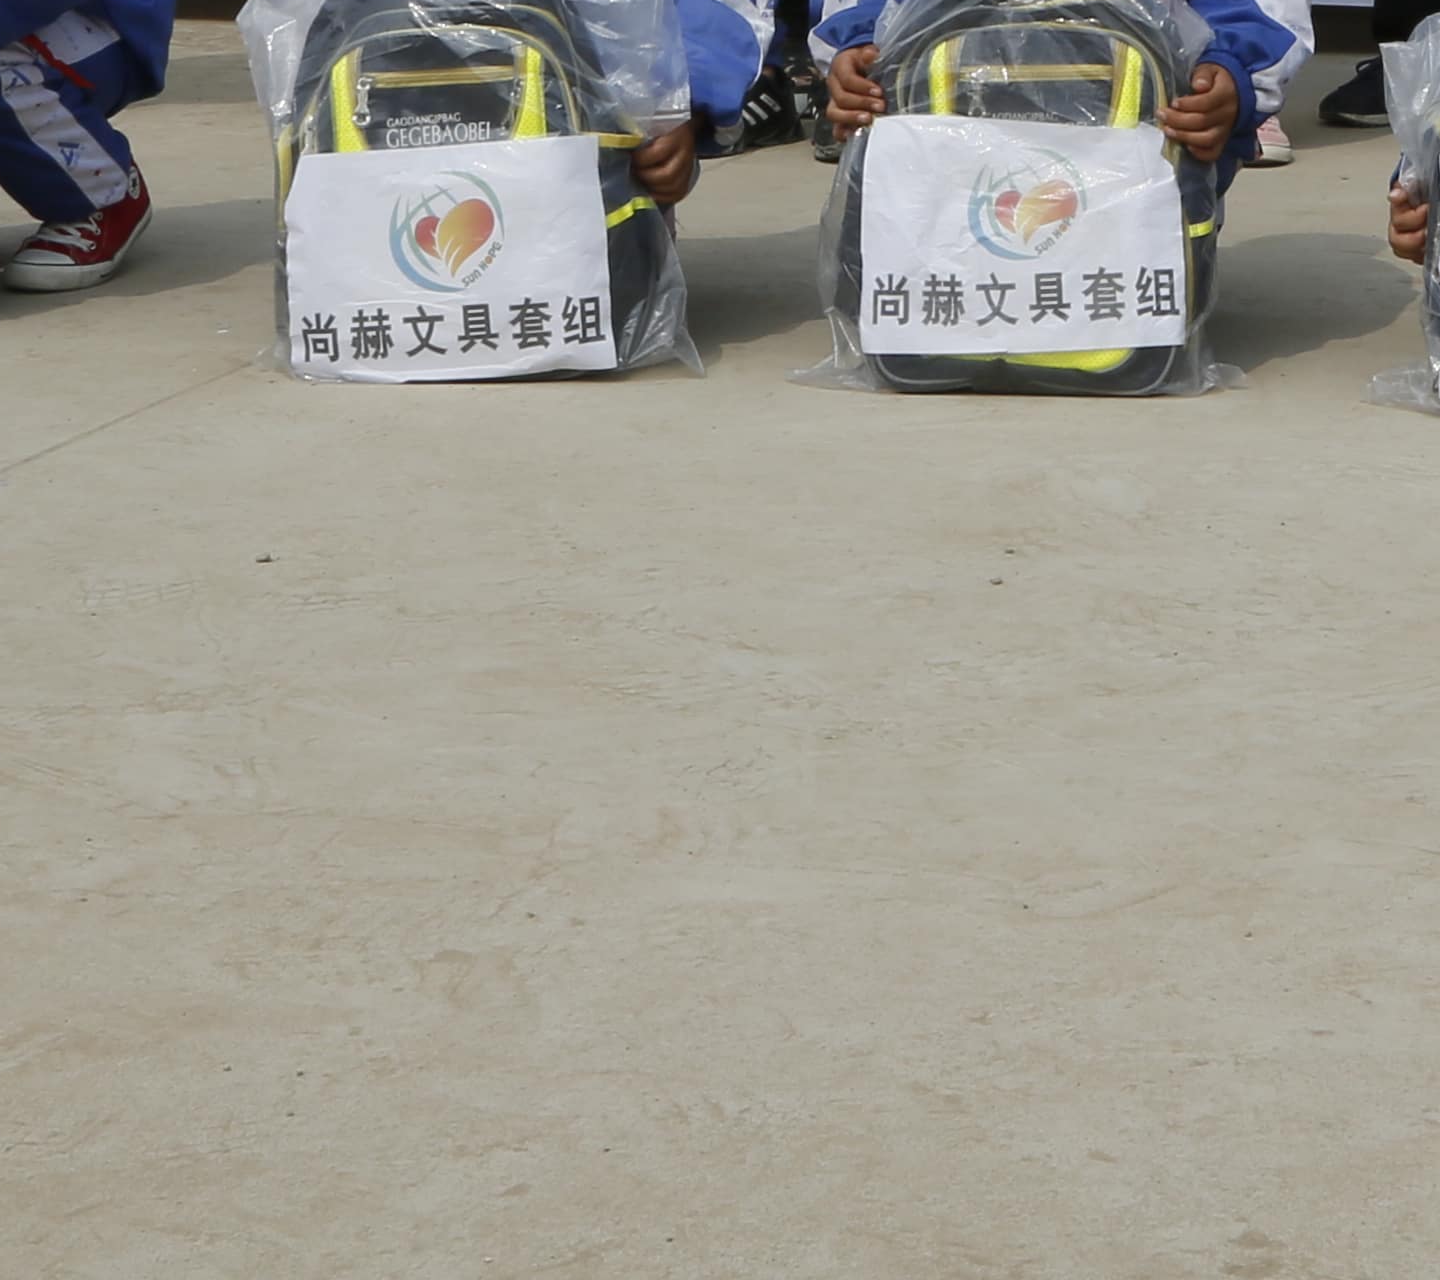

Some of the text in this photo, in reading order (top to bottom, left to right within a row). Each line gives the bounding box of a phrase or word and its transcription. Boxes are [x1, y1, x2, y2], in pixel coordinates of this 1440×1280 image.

[386, 121, 491, 149] GEGEBAOBEI
[871, 266, 1180, 327] 尚赫文具套组
[301, 295, 606, 364] 尚赫文具套组
